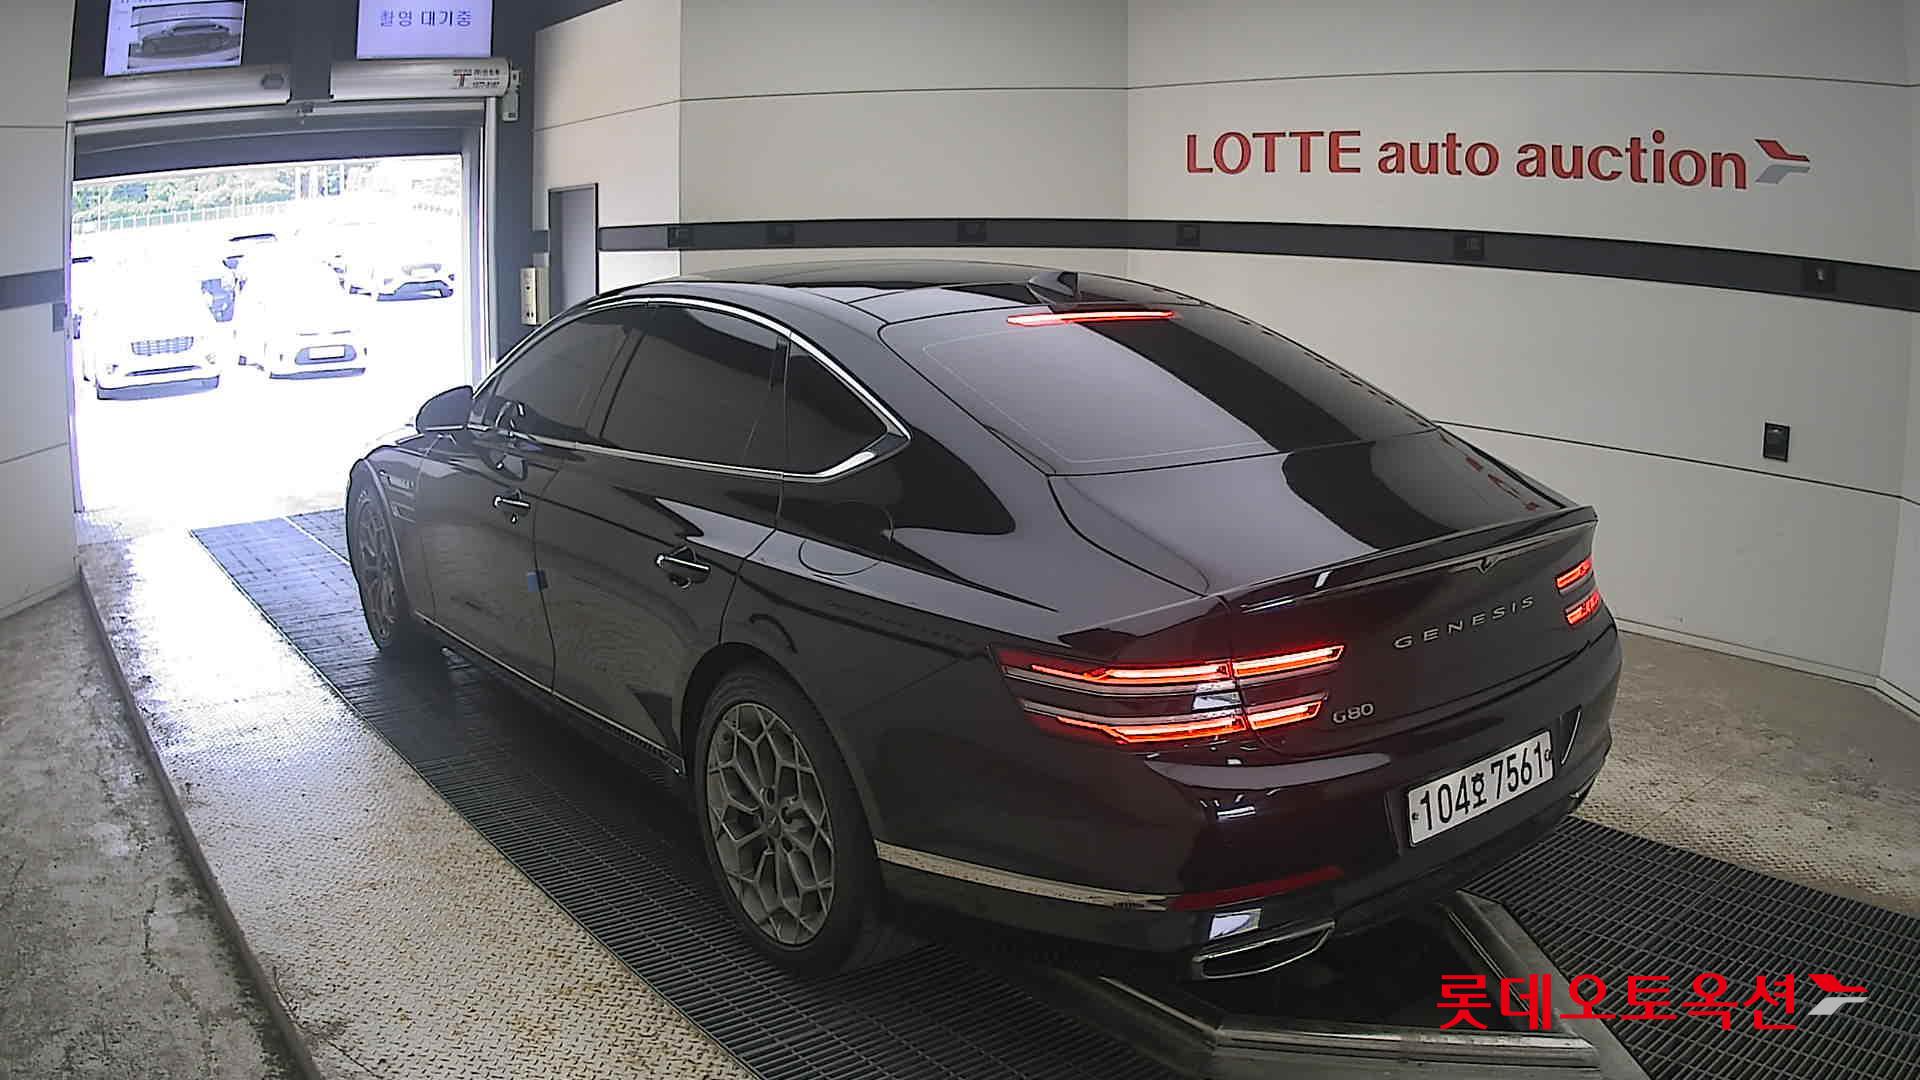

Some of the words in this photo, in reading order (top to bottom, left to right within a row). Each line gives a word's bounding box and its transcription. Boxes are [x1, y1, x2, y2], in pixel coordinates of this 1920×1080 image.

[421, 10, 472, 28] 대기중
[1186, 130, 1361, 175] LOTTE
[1377, 132, 1500, 177] auto
[1515, 129, 1748, 190] auction
[1393, 595, 1535, 649] GENESIS
[1331, 702, 1375, 725] G80
[1491, 741, 1544, 800] 7561
